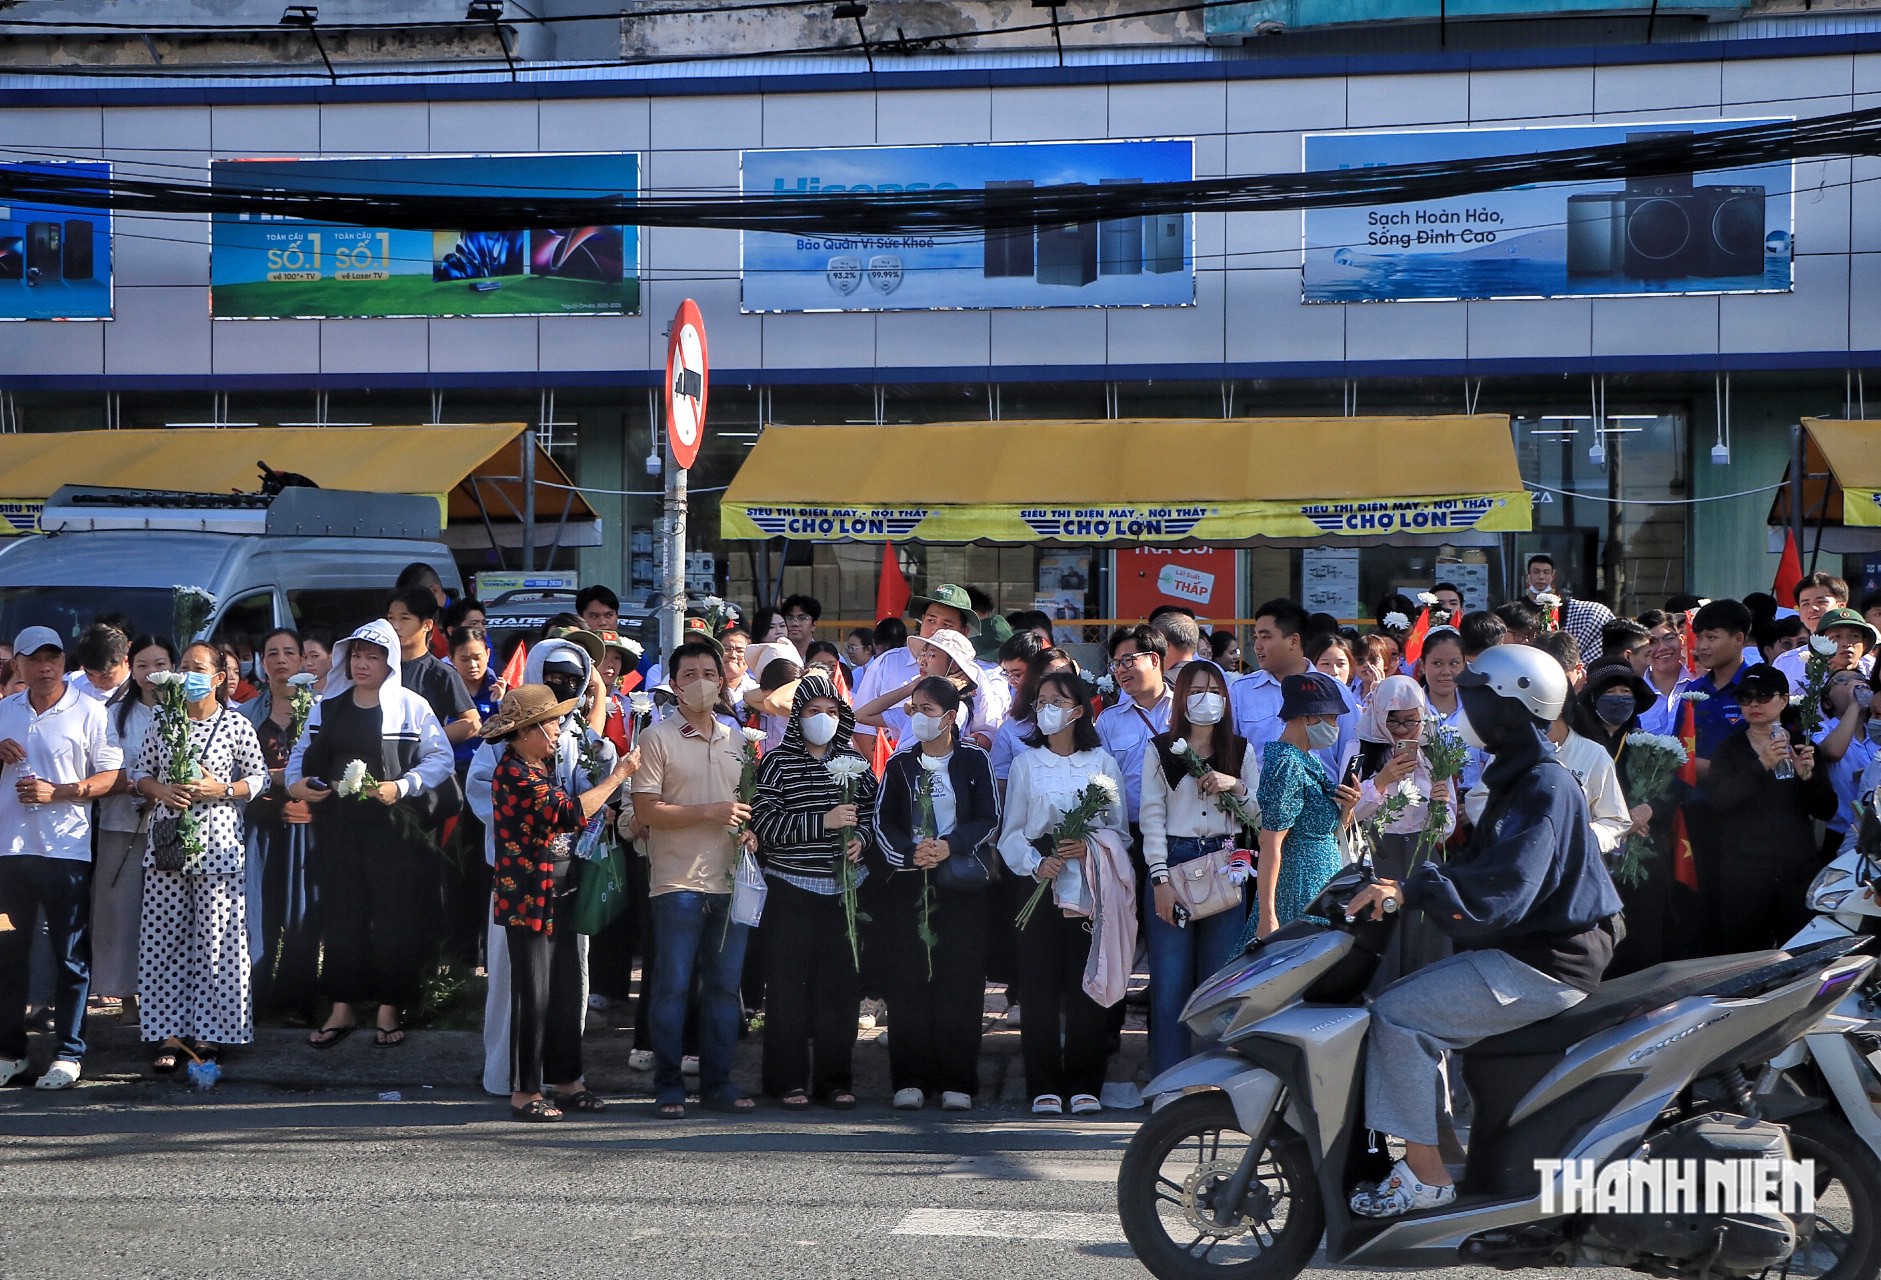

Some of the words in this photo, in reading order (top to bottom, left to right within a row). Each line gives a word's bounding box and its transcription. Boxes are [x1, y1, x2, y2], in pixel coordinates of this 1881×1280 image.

[1368, 211, 1410, 229] Sạch
[1415, 209, 1460, 224] Hoàn
[1466, 207, 1504, 224] Hảo,
[266, 232, 286, 240] TOÀN
[288, 232, 304, 240] CẦU
[356, 231, 372, 239] CẦU
[1368, 229, 1411, 248] Sống
[1417, 229, 1455, 244] Đỉnh
[1461, 229, 1496, 243] Cao
[797, 239, 820, 250] Bảo
[0, 503, 22, 512] SIÊU
[747, 507, 772, 516] SIÊU
[1020, 508, 1047, 518] SIÊU
[1051, 509, 1070, 519] THỊ
[1075, 509, 1104, 519] ĐIỆN
[1148, 508, 1172, 518] NỘI
[1176, 506, 1206, 517] THẤT
[1301, 503, 1329, 514] SIÊU
[788, 518, 836, 536] CHỢ
[839, 515, 884, 534] LỚN
[1346, 512, 1396, 532] CHỢ
[1400, 508, 1448, 528] LỚN
[1063, 520, 1110, 538] CHỢ
[1115, 516, 1162, 535] LỚN
[1174, 580, 1208, 596] THẤP
